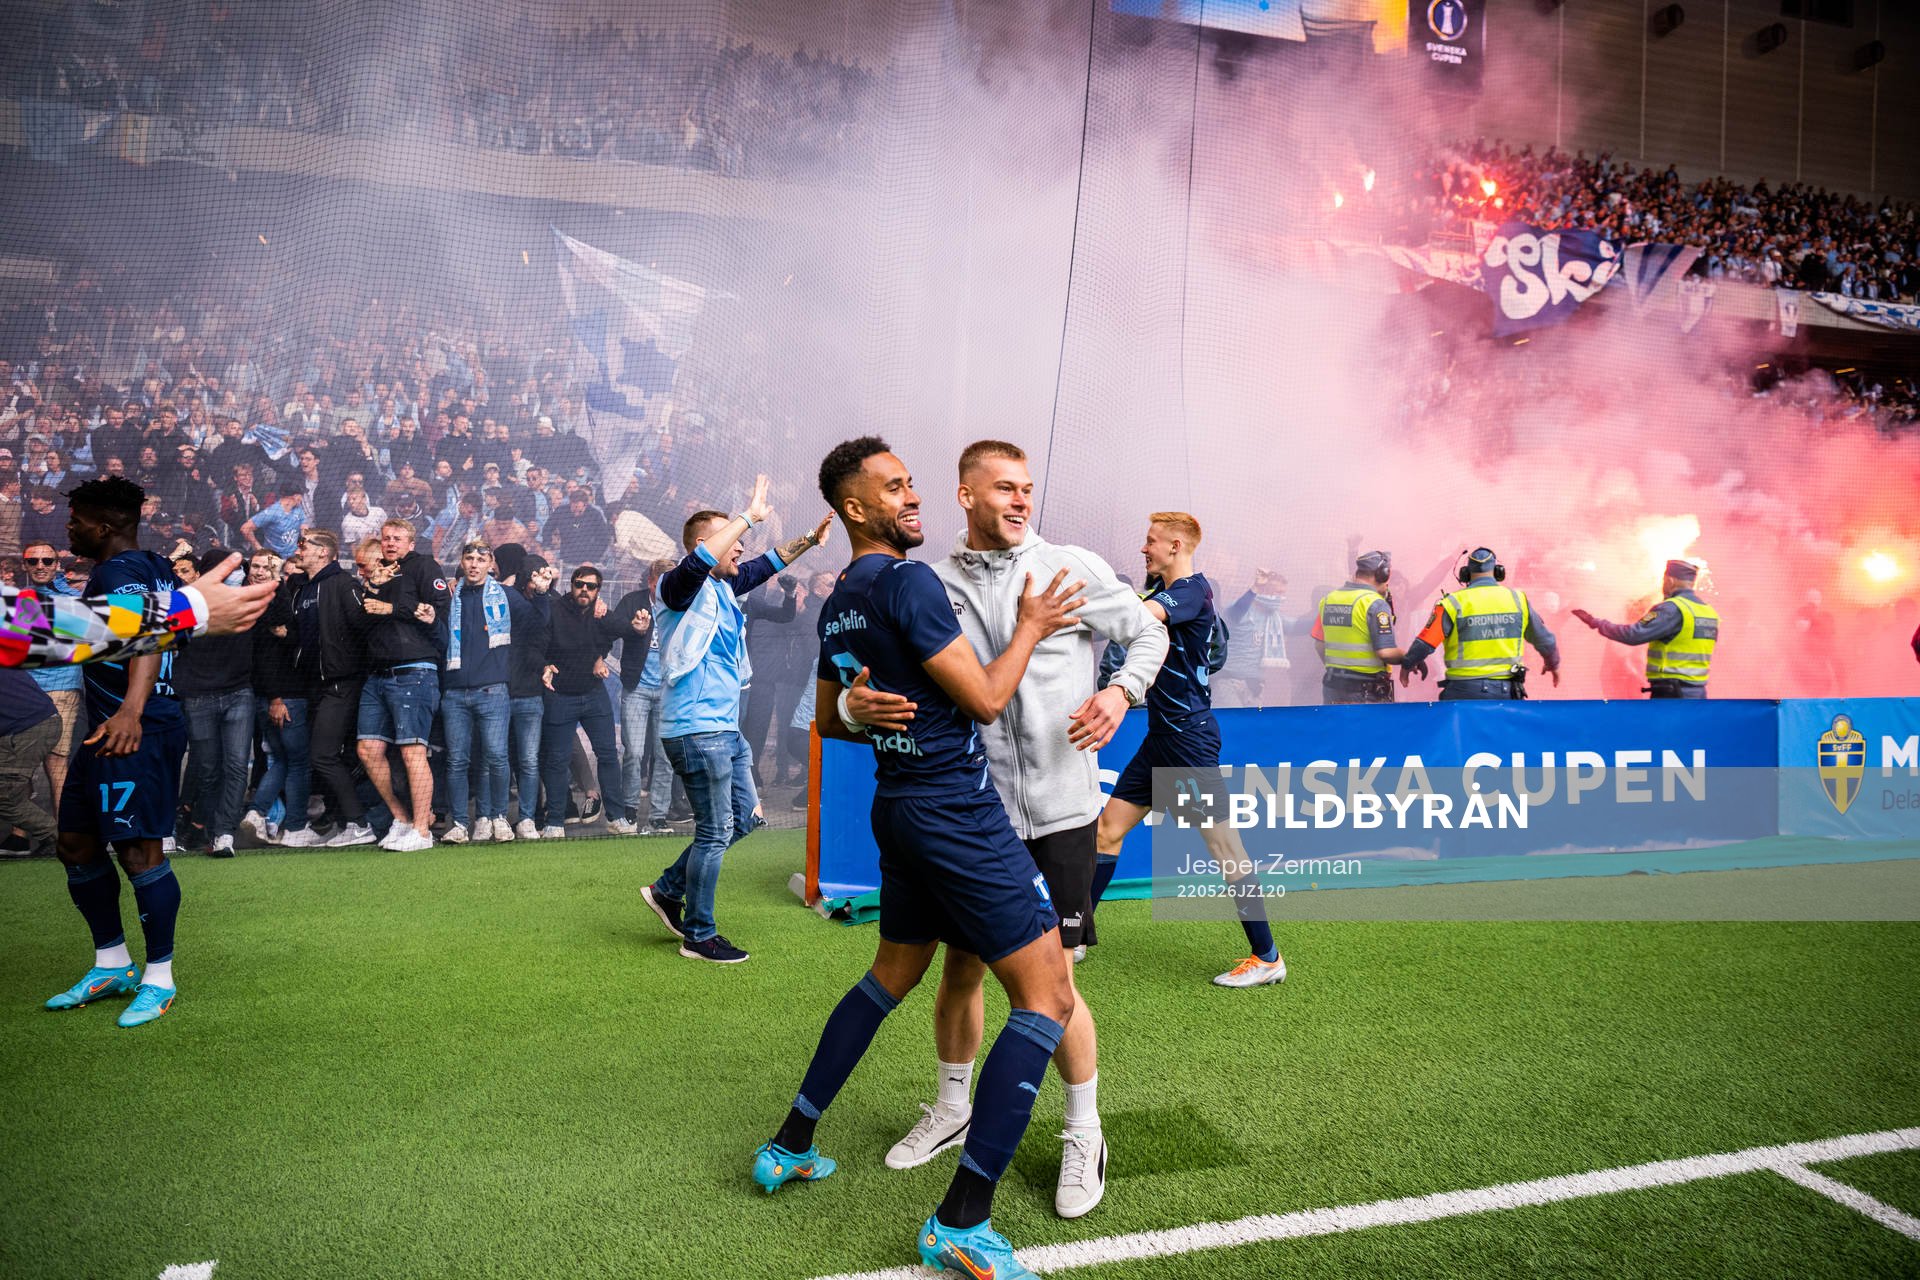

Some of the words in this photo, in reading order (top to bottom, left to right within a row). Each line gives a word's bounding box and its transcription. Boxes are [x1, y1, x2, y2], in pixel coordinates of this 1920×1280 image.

[1467, 614, 1516, 626] ORDNINGS
[1481, 628, 1505, 638] VAKT
[99, 781, 136, 812] 17
[1098, 755, 1440, 826] SNSKA
[1462, 749, 1706, 808] CUPEN
